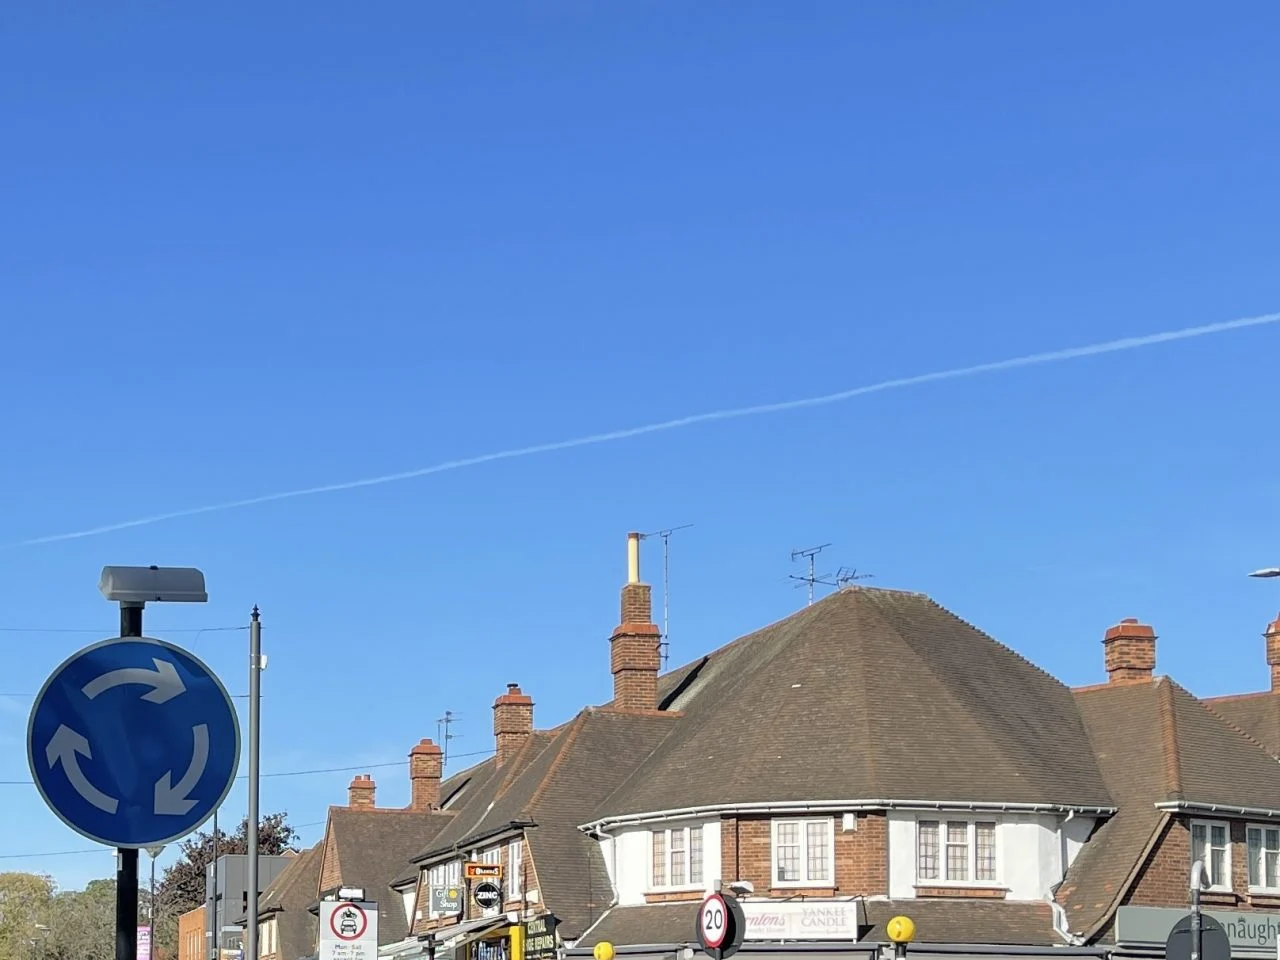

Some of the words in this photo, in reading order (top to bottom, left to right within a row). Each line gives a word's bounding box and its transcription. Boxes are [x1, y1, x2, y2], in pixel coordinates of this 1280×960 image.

[477, 891, 498, 900] ZINC
[440, 897, 458, 910] Shop
[801, 907, 846, 917] YANKEE
[705, 909, 723, 930] 20
[800, 917, 847, 927] CANDLE
[1220, 917, 1280, 945] naugh
